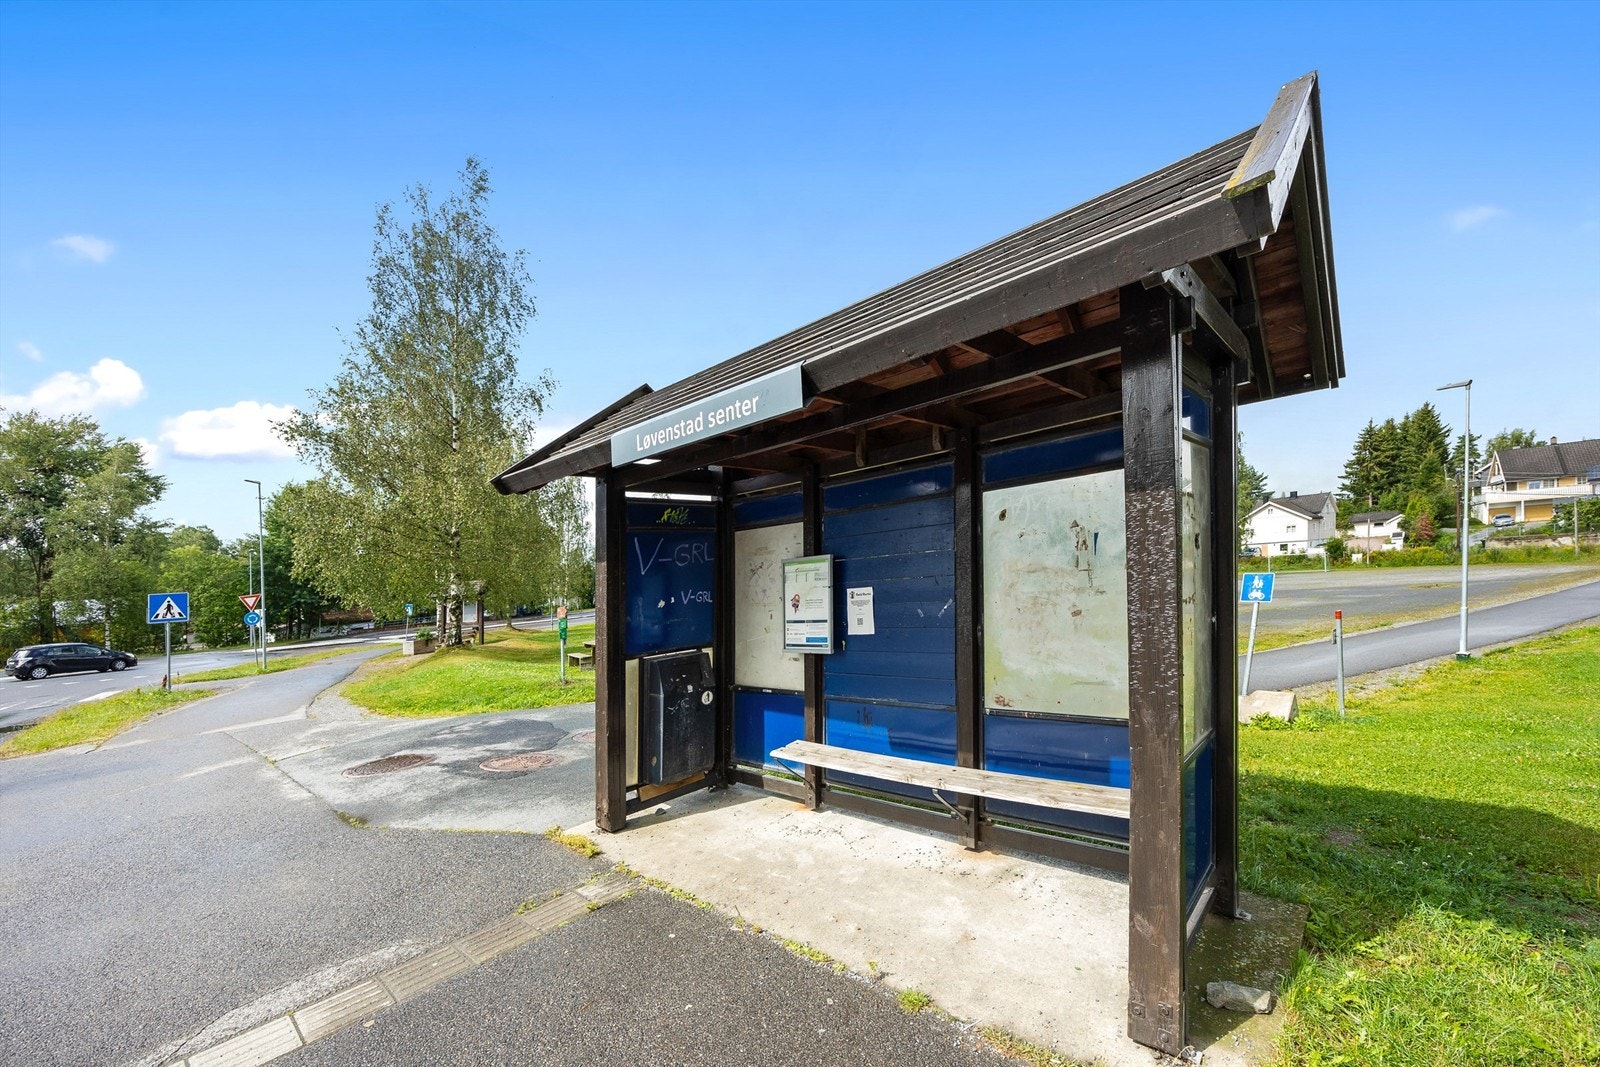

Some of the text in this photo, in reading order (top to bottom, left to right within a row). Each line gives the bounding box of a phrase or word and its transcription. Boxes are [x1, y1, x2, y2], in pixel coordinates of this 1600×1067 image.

[635, 396, 759, 452] Løvenstad senter
[680, 589, 713, 605] V-GRL
